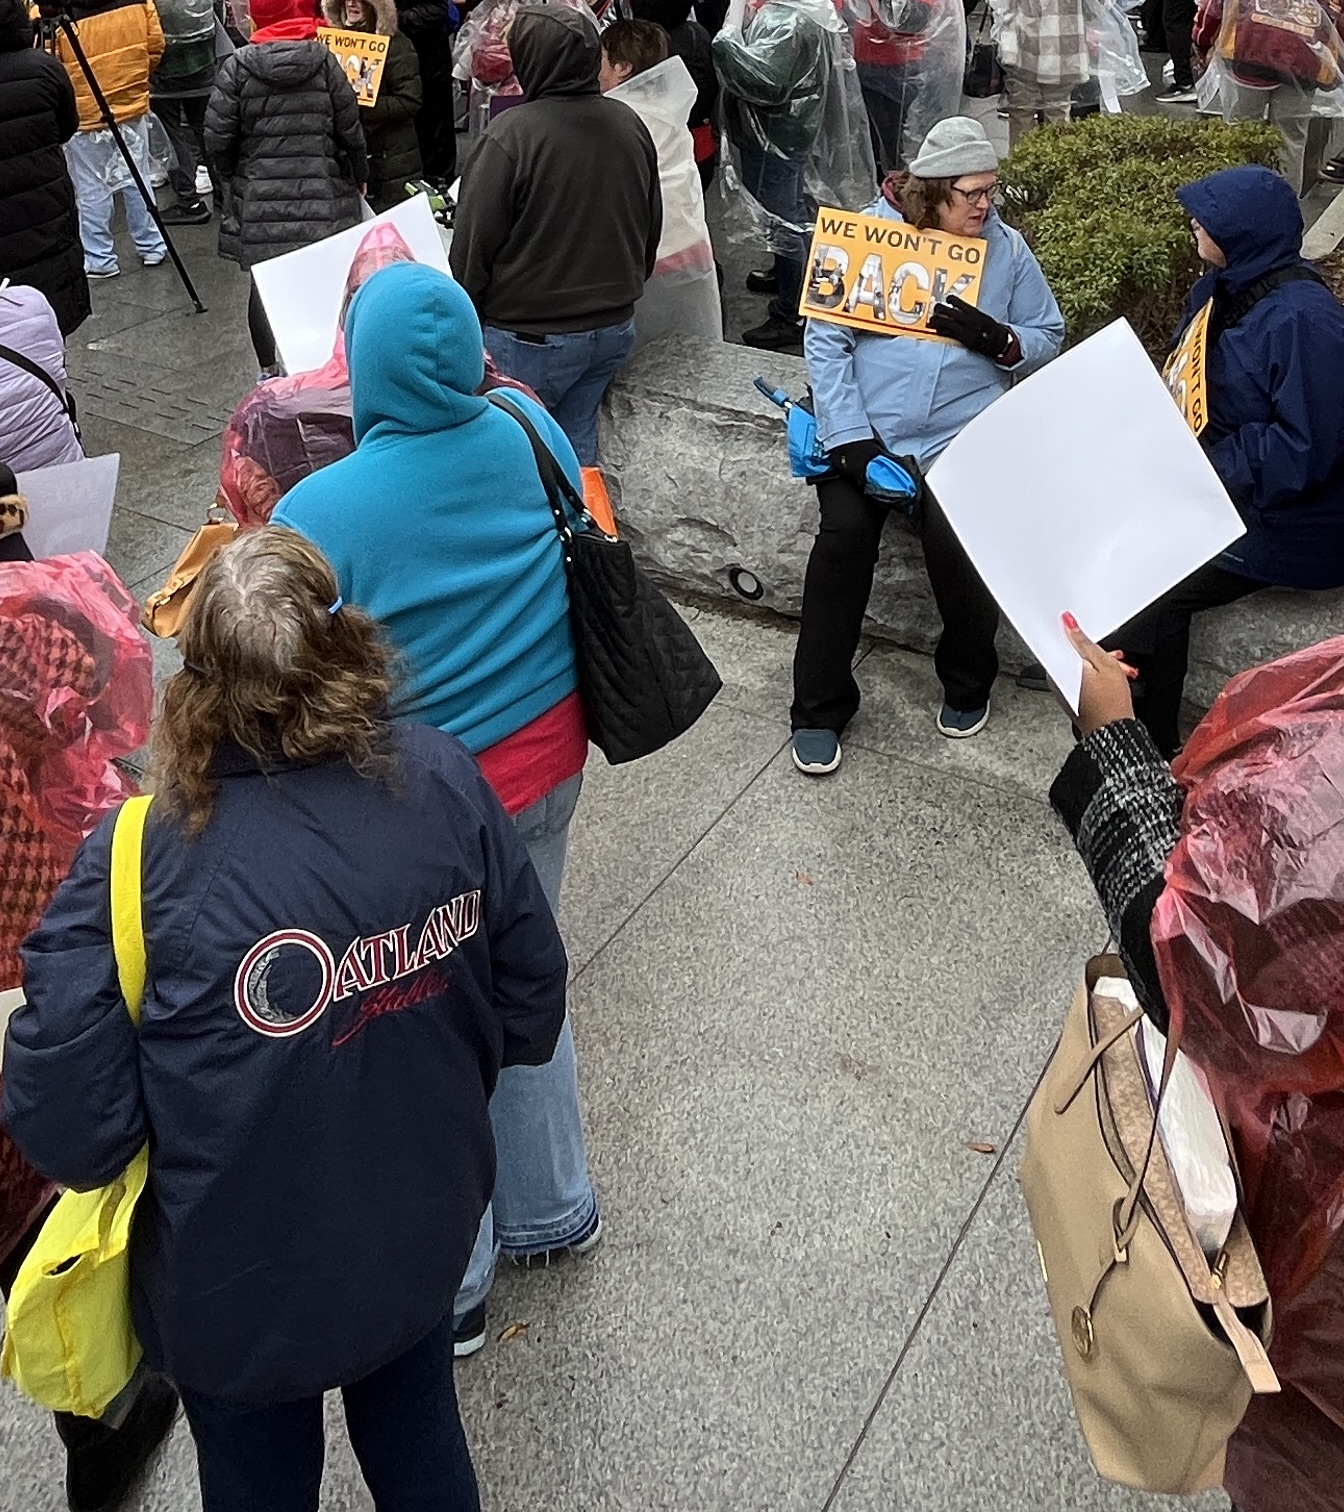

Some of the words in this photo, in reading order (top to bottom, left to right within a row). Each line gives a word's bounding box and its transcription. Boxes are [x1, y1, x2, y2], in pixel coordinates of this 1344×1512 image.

[335, 34, 367, 49] WON'T
[368, 40, 386, 53] GO
[821, 216, 857, 239] WE
[864, 224, 943, 256] WON'T
[947, 243, 981, 265] GO
[806, 242, 977, 329] BACK
[1192, 397, 1203, 433] GO
[234, 889, 481, 1038] OATLAND
